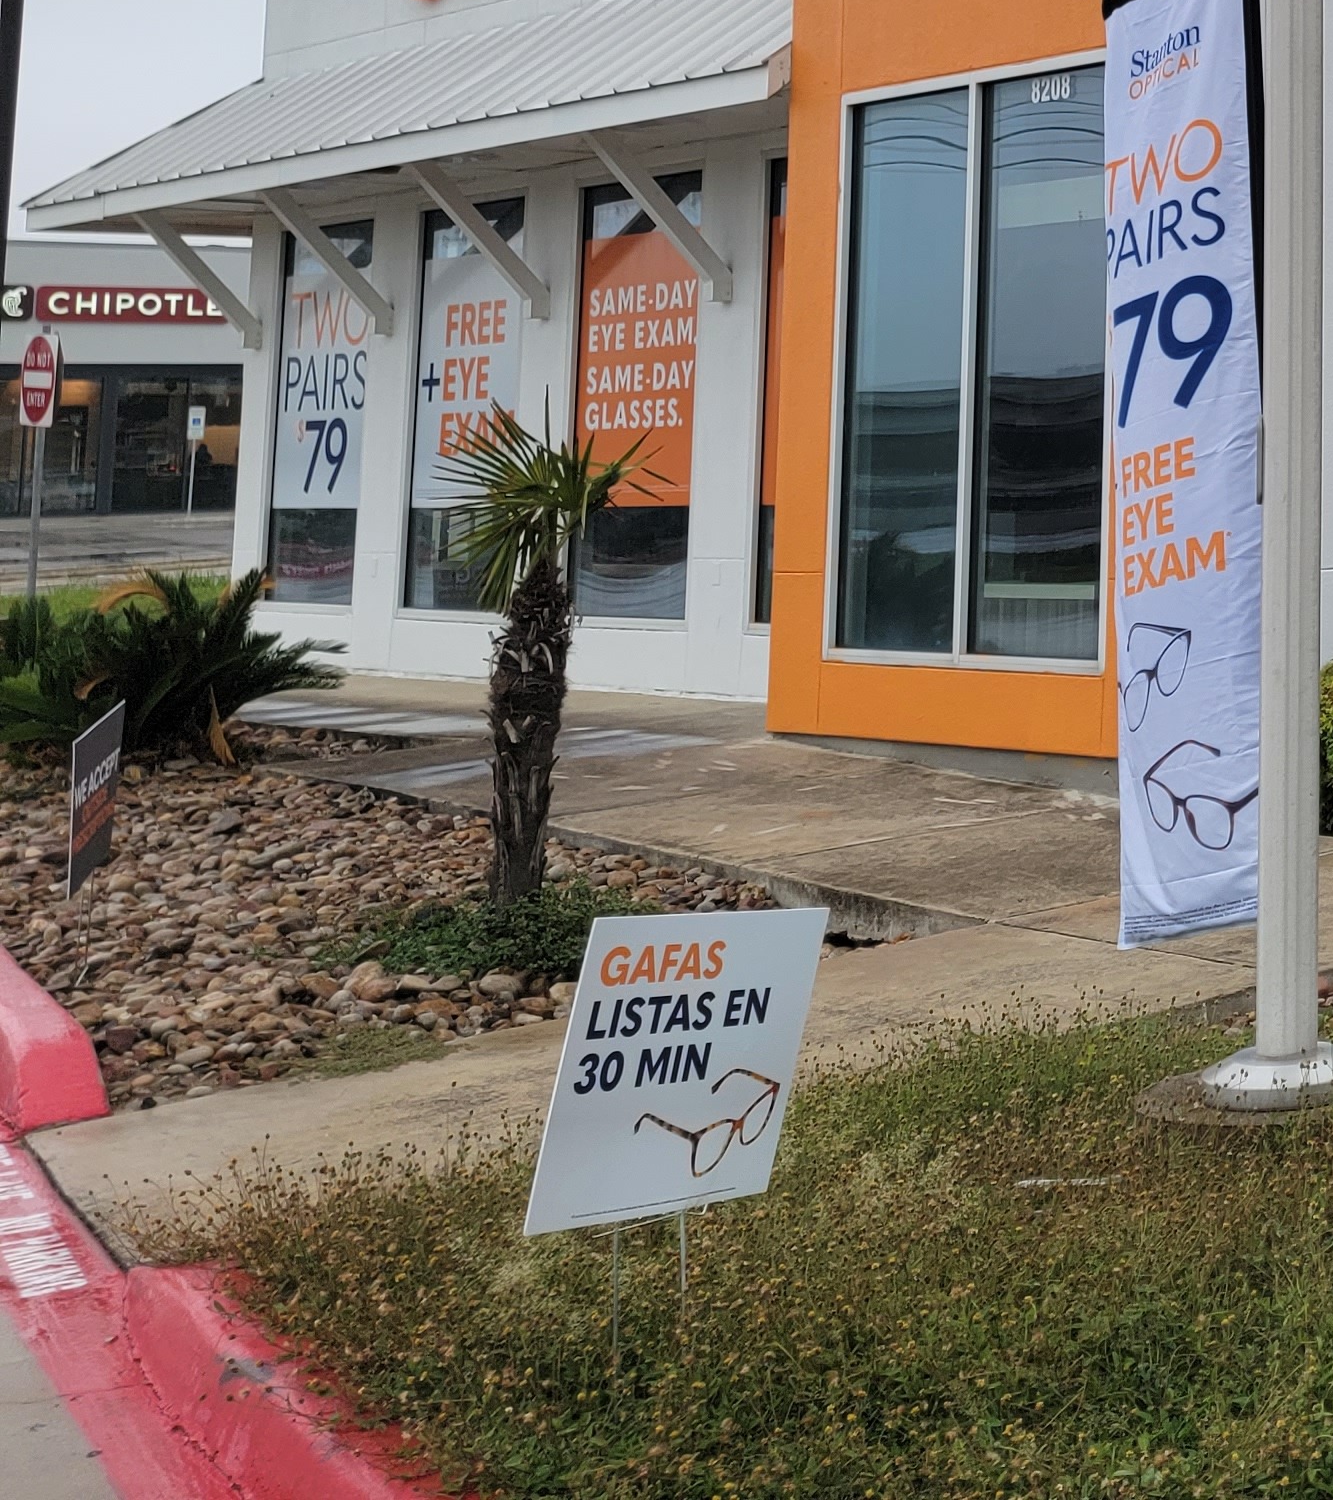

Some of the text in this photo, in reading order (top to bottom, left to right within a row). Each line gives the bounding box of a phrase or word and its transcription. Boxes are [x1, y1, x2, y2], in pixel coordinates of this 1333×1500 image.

[1129, 47, 1199, 100] OPTICAL
[1130, 25, 1200, 78] Stanton
[1031, 74, 1070, 104] 8208
[1105, 118, 1222, 217] TWO
[48, 290, 223, 317] CHIPOTLE
[292, 287, 369, 350] TWO
[589, 278, 697, 317] SAME-DAY
[445, 299, 507, 348] FREE
[588, 322, 625, 353] EYE
[26, 351, 51, 369] DO NOT
[284, 349, 367, 412] PAIRS
[442, 355, 490, 401] EYE
[586, 360, 694, 395] SAME-DAY
[26, 390, 46, 408] ENTER
[584, 397, 683, 431] GLASSES.
[296, 416, 348, 494] $79
[438, 409, 516, 457] EXAM
[1121, 436, 1196, 498] FREE
[1122, 492, 1175, 548] EYE
[1123, 530, 1227, 598] EXAM
[74, 777, 87, 809] WE
[87, 748, 120, 793] ACCEPT
[600, 940, 727, 987] GAFAS
[585, 986, 772, 1041] LISTAS EN
[573, 1041, 713, 1096] 30 MIN
